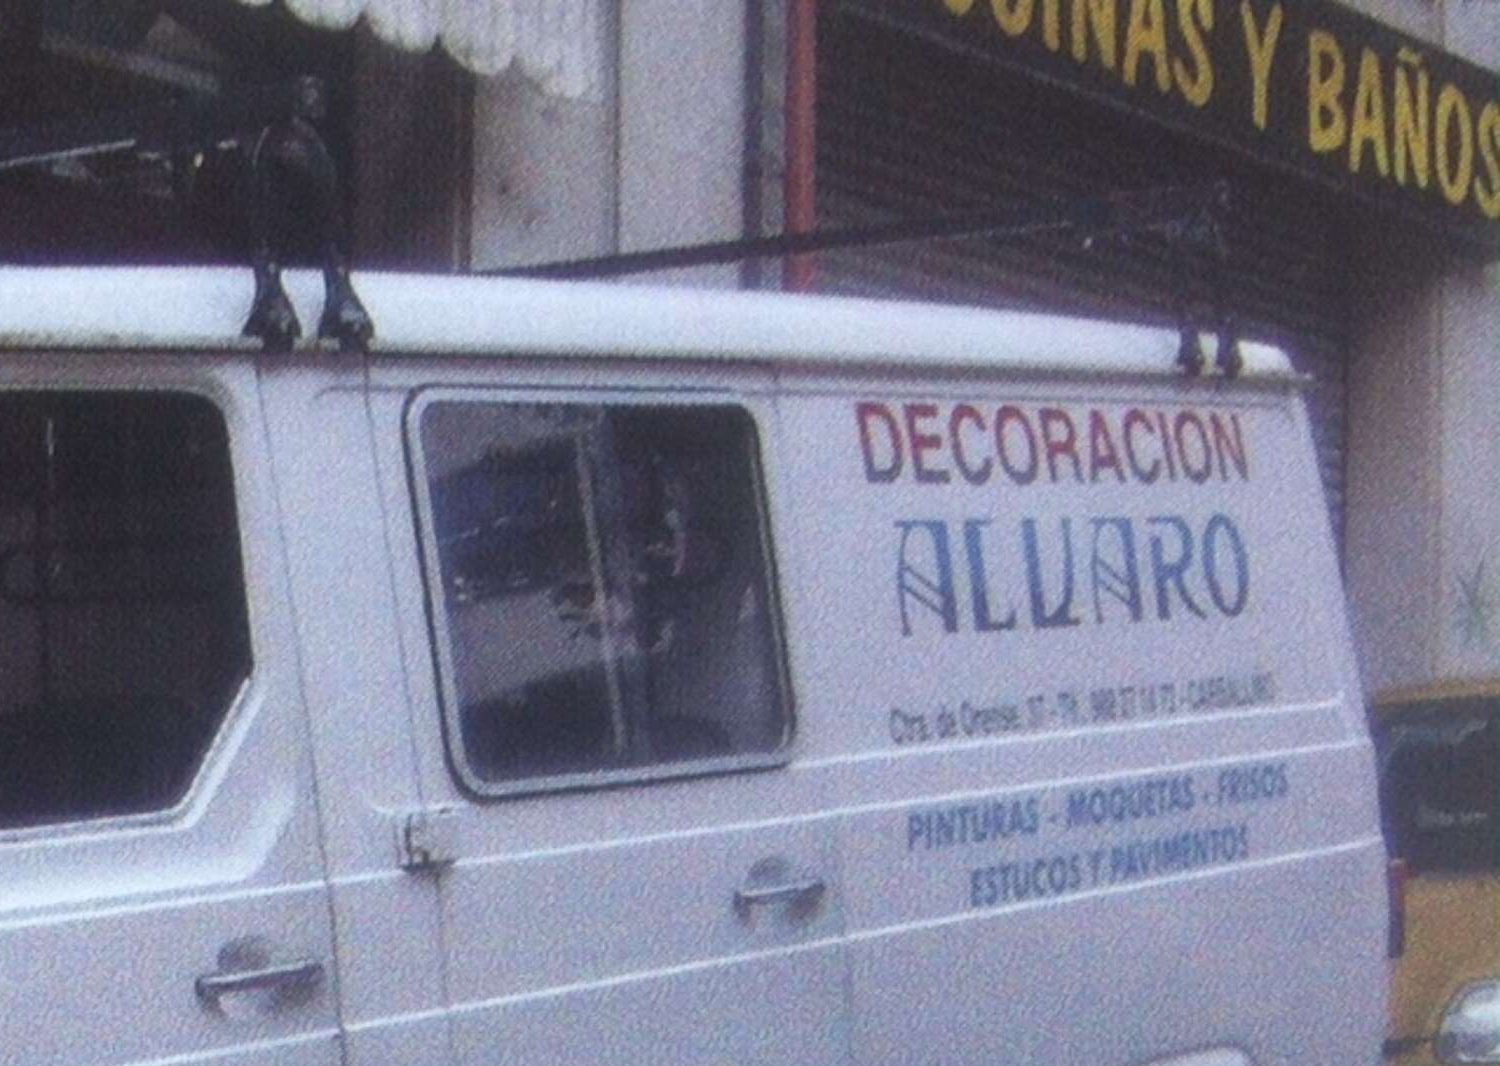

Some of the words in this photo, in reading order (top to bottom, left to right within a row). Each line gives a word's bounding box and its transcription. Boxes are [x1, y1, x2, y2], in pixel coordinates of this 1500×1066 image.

[940, 0, 1214, 106] NAS
[1240, 2, 1282, 131] Y
[1308, 28, 1500, 219] BAÑOS
[856, 402, 1250, 486] DECORACION
[908, 798, 1038, 850] PINTURAS
[1066, 775, 1195, 828] MOQUETAS
[1218, 763, 1289, 807] FRISOS
[970, 854, 1082, 907] ESTUCOS
[1088, 850, 1103, 884] Y
[1110, 825, 1249, 882] PAVIMENTOS
